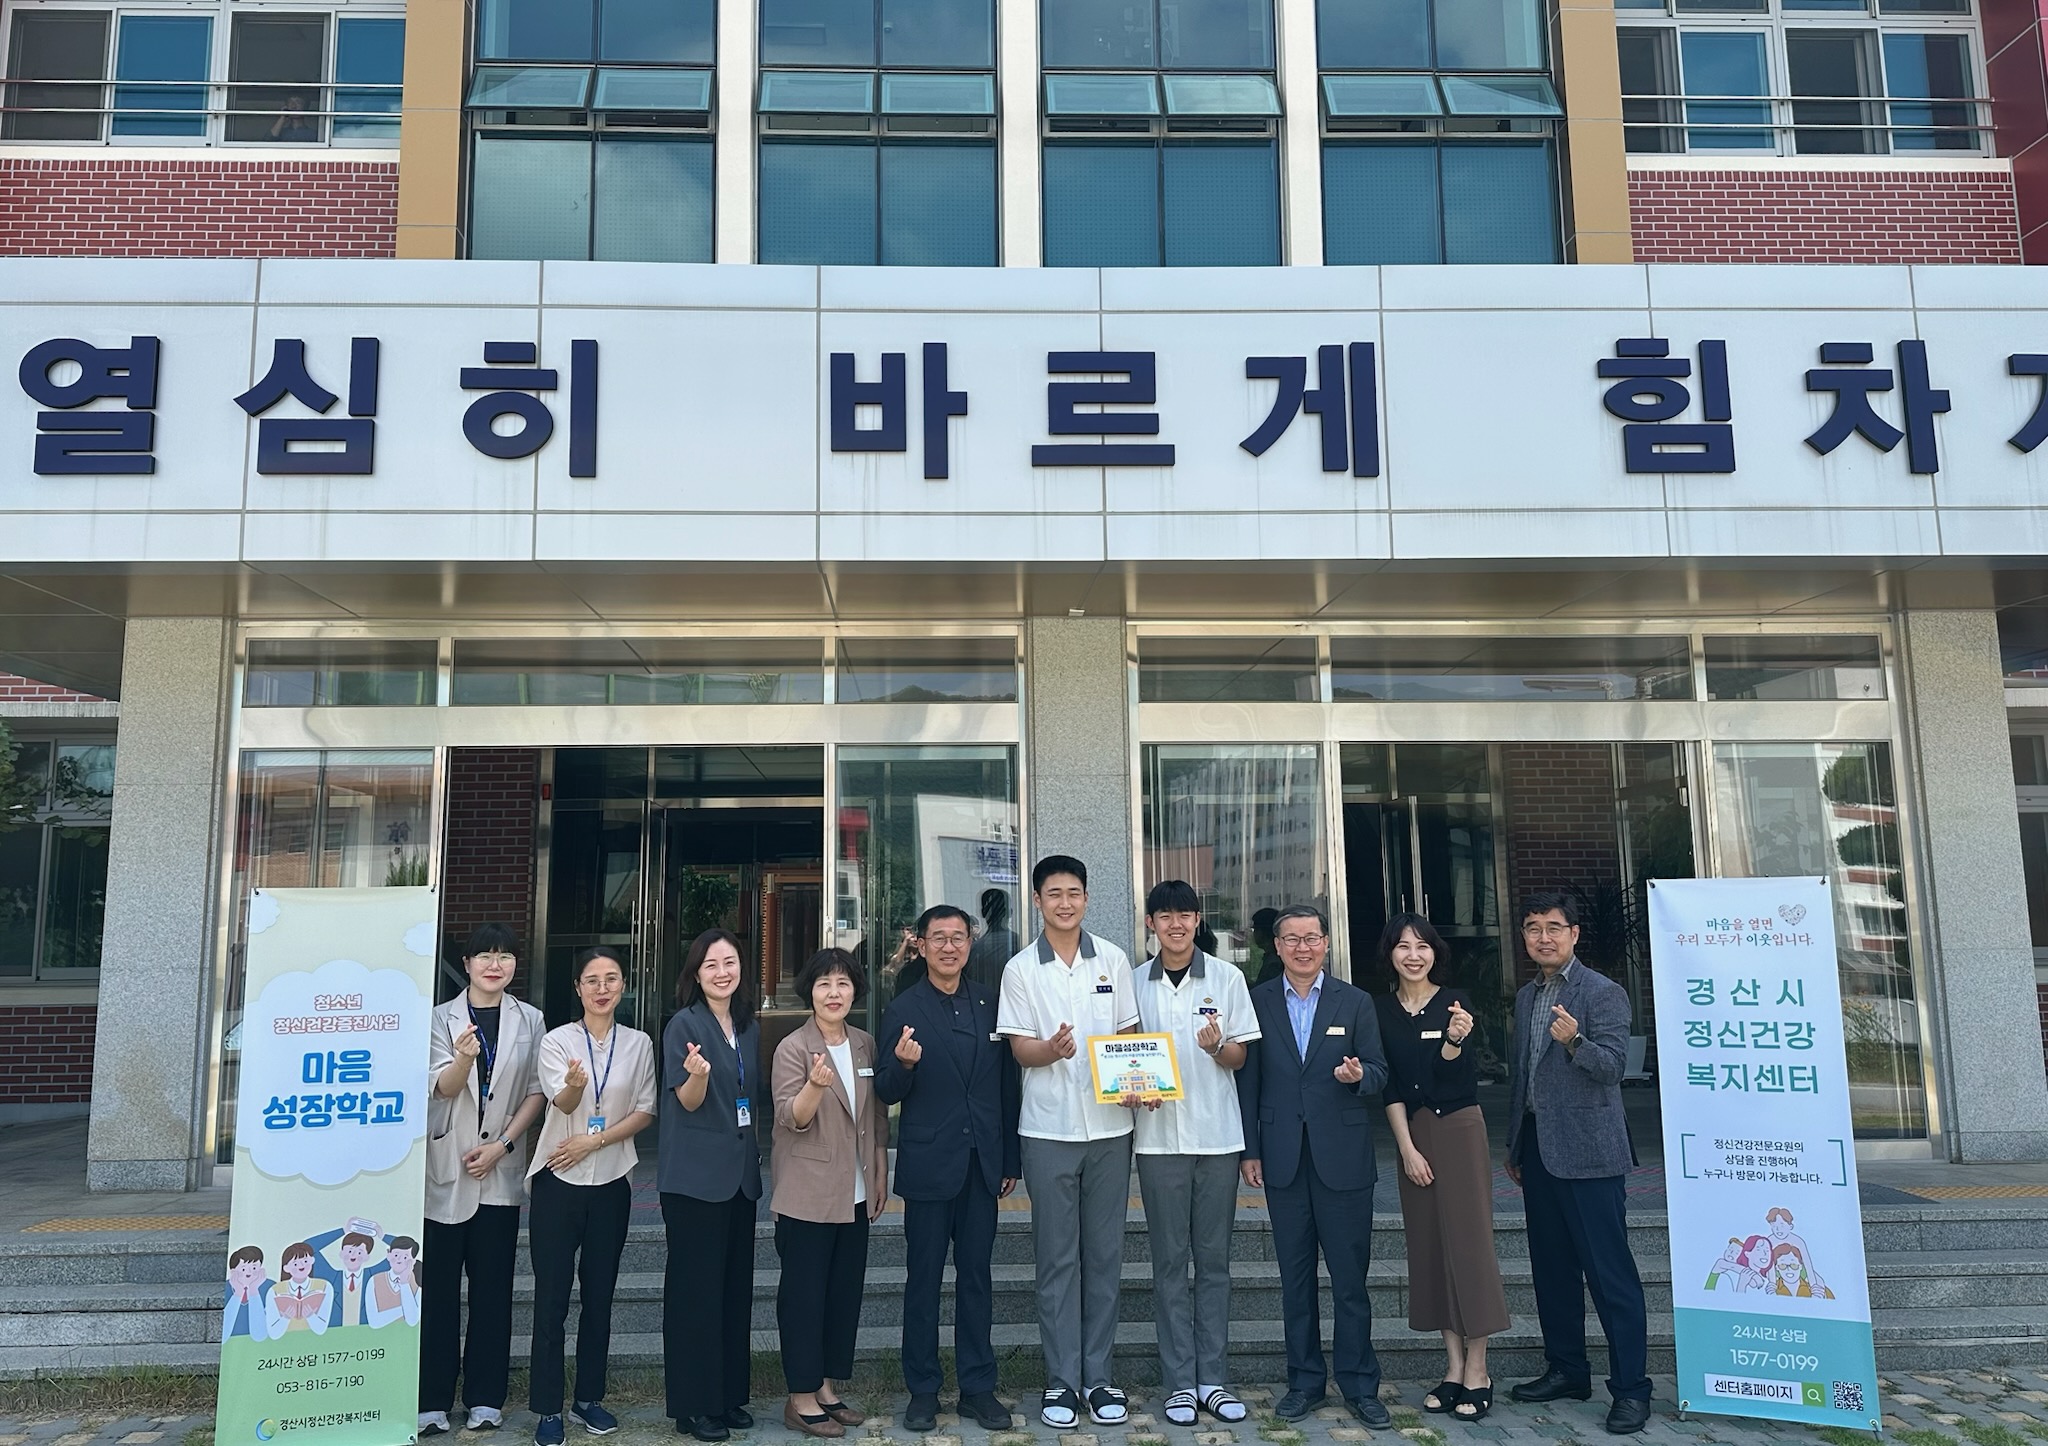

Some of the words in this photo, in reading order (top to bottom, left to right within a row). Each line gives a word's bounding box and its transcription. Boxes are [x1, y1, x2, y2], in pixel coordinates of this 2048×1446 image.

[19, 336, 599, 478] 열심히
[830, 341, 1380, 479] 바르게
[1706, 918, 1744, 931] 마음을
[1748, 917, 1773, 931] 열면
[1675, 933, 1699, 946] 우리
[1704, 933, 1742, 946] 모두가
[1746, 933, 1814, 947] 이웃입니다.
[314, 993, 362, 1012] 청소년
[273, 1013, 400, 1035] 정신건강증진사업
[1683, 1020, 1816, 1050] 정신건강
[302, 1049, 372, 1084] 마음
[1686, 1062, 1819, 1094] 복지센터
[262, 1091, 405, 1130] 성장학교
[1714, 1138, 1804, 1153] 정신건강전문요원의
[1725, 1154, 1755, 1167] 상담을
[1758, 1156, 1798, 1168] 진행하여
[1704, 1168, 1733, 1180] 누구나
[1736, 1170, 1766, 1182] 방문이
[1769, 1171, 1823, 1185] 가능합니다.
[1732, 1325, 1777, 1341] 24시간
[1781, 1328, 1808, 1343] 상담
[257, 1357, 294, 1371] 24시간
[296, 1354, 318, 1369] 상담
[322, 1348, 385, 1365] 1577-0199
[1730, 1349, 1819, 1371] 1577-0199
[276, 1375, 365, 1394] 053-816-7190
[1713, 1379, 1793, 1399] 센터홈페이지
[279, 1409, 381, 1431] 경산시정신건강복지센터
